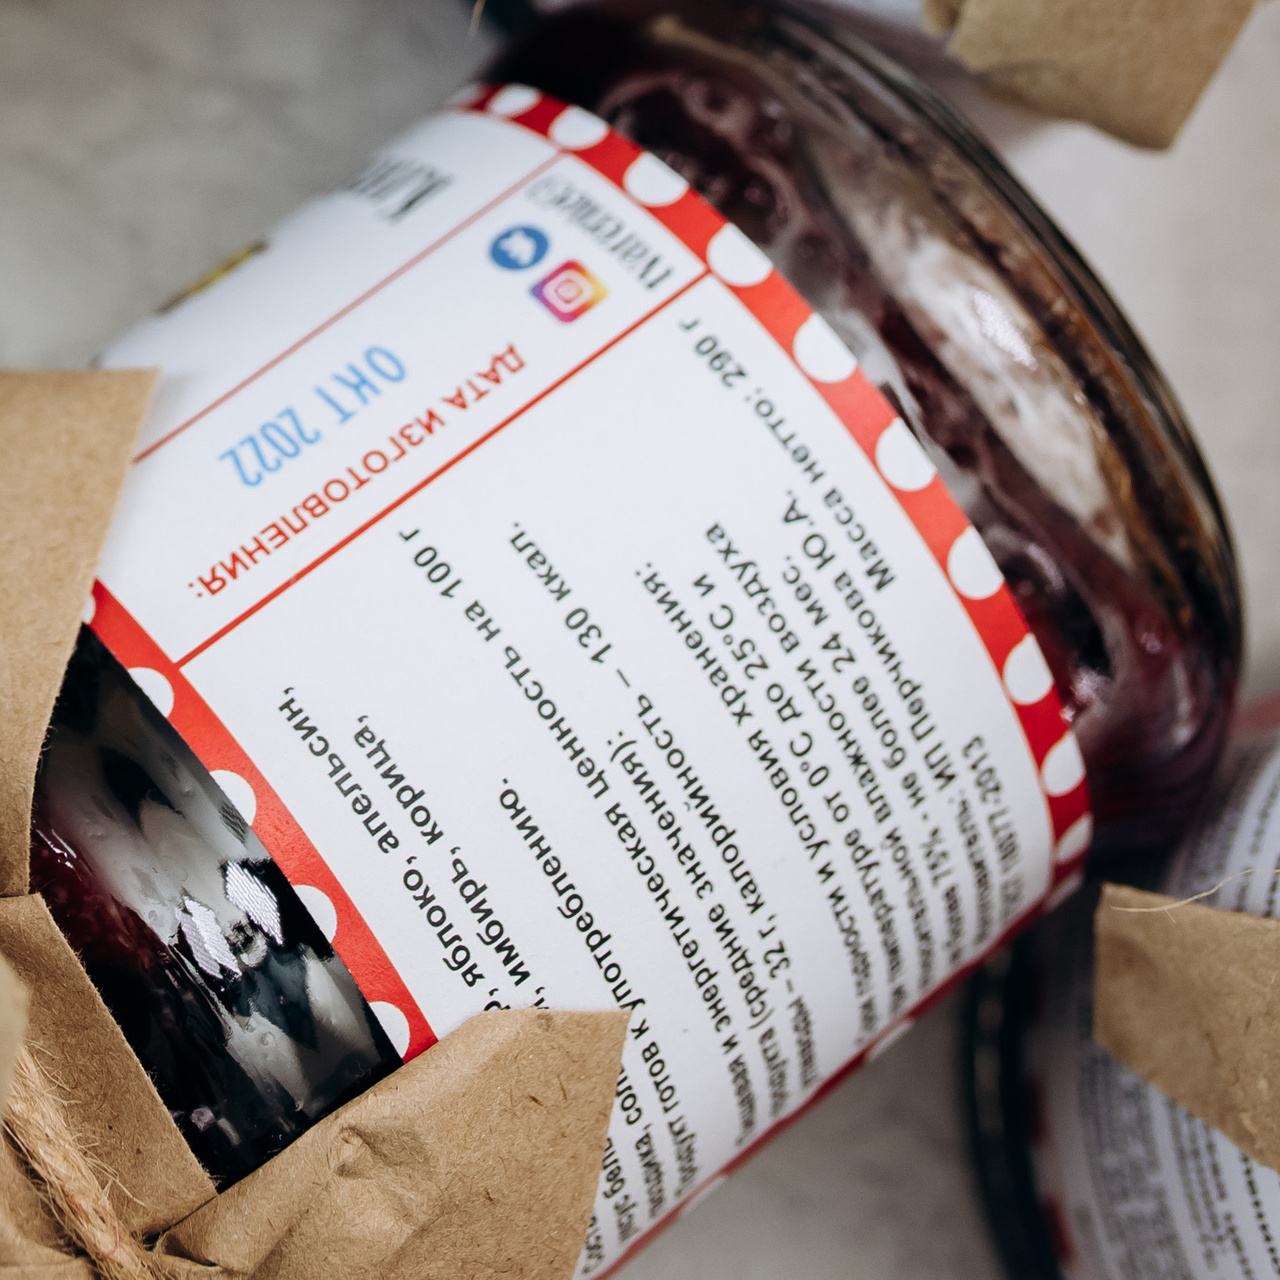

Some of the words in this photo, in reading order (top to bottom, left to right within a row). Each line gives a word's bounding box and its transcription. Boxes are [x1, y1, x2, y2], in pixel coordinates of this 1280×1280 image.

[442, 344, 526, 411] ДАТА
[694, 335, 748, 389] 290
[218, 406, 322, 488] 2022
[745, 388, 826, 485] нетто:
[188, 408, 445, 598] ИЗГОТОВЛЕНИЯ:
[398, 528, 421, 543] г
[782, 490, 836, 572] Ю.А.
[823, 487, 896, 593] Масса
[413, 545, 462, 599] 100
[509, 522, 572, 602] ккал.
[692, 573, 716, 598] и
[705, 522, 801, 655] воздуха
[782, 556, 829, 627] мес.
[464, 599, 502, 643] на
[564, 607, 613, 665] 130
[635, 562, 754, 727] хранения:
[820, 632, 857, 674] 24
[833, 571, 937, 744] Перчикова
[504, 645, 611, 800] ценность
[765, 682, 803, 724] до
[796, 658, 893, 825] влажности
[852, 675, 907, 770] более
[278, 686, 400, 855] апельсин,
[353, 715, 445, 846] корица,
[637, 694, 766, 916] калорийность
[747, 729, 831, 861] условия
[823, 791, 850, 824] от
[923, 742, 958, 791] ИП
[607, 731, 714, 901] значения):
[499, 778, 647, 1011] употреблению.
[816, 861, 836, 884] и
[402, 855, 486, 988] яблоко,
[449, 846, 531, 987] имбирь,
[604, 802, 732, 1034] энергетическая
[762, 940, 791, 980] 32
[630, 1018, 650, 1041] к
[641, 1041, 680, 1115] готов
